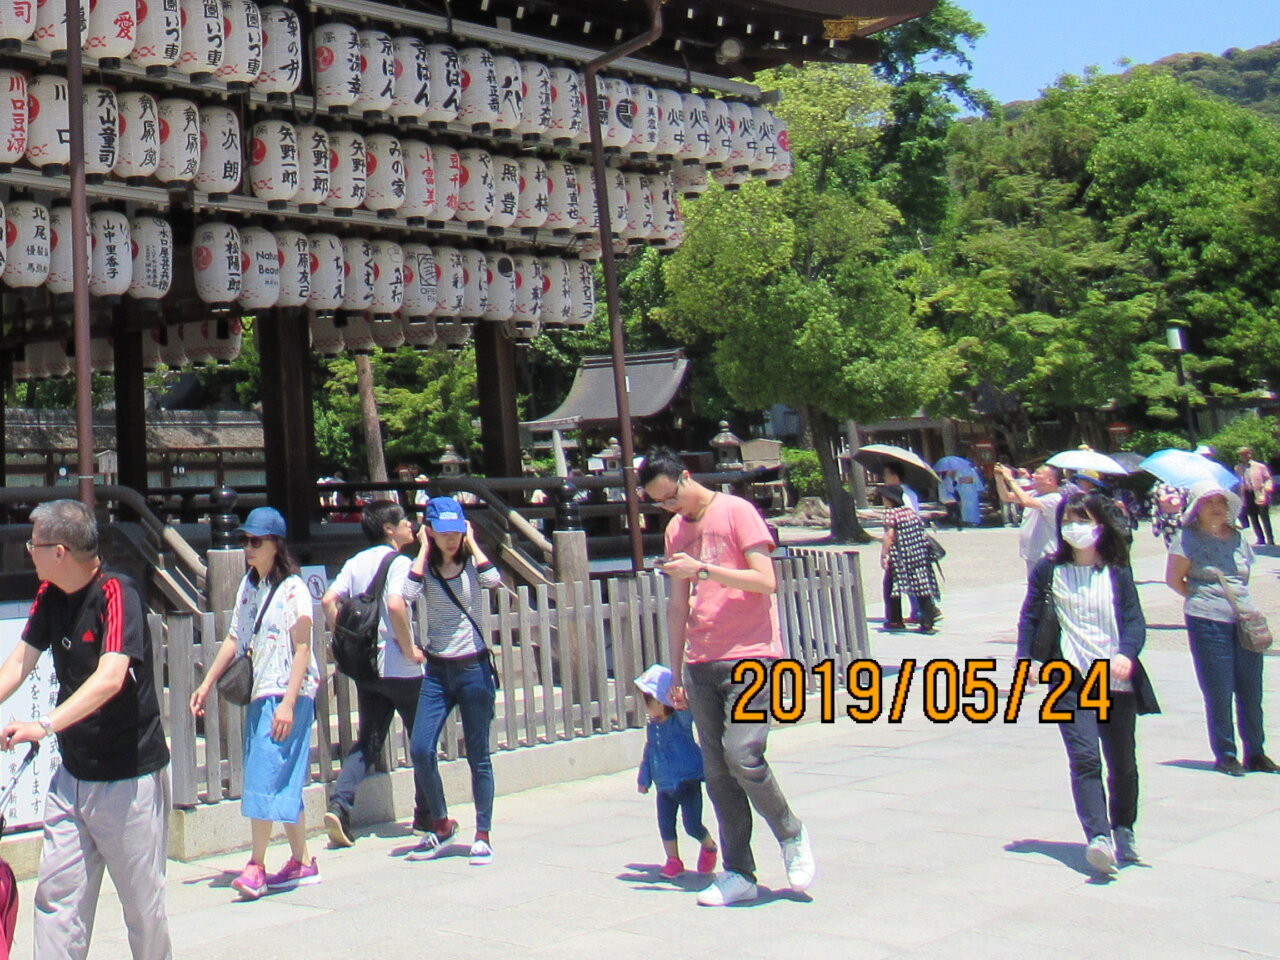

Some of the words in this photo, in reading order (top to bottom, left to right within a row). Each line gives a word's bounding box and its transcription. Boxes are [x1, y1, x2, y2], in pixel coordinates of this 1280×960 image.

[221, 128, 240, 183] 次朗
[278, 125, 298, 190] 矢野一郎
[312, 131, 329, 197] 矢野一郎
[350, 139, 366, 200] 矢野一郎
[388, 140, 406, 198] みの家
[32, 206, 48, 241] 北尾
[102, 219, 119, 280] 山中里香子
[223, 227, 241, 294] 小松陽一郎
